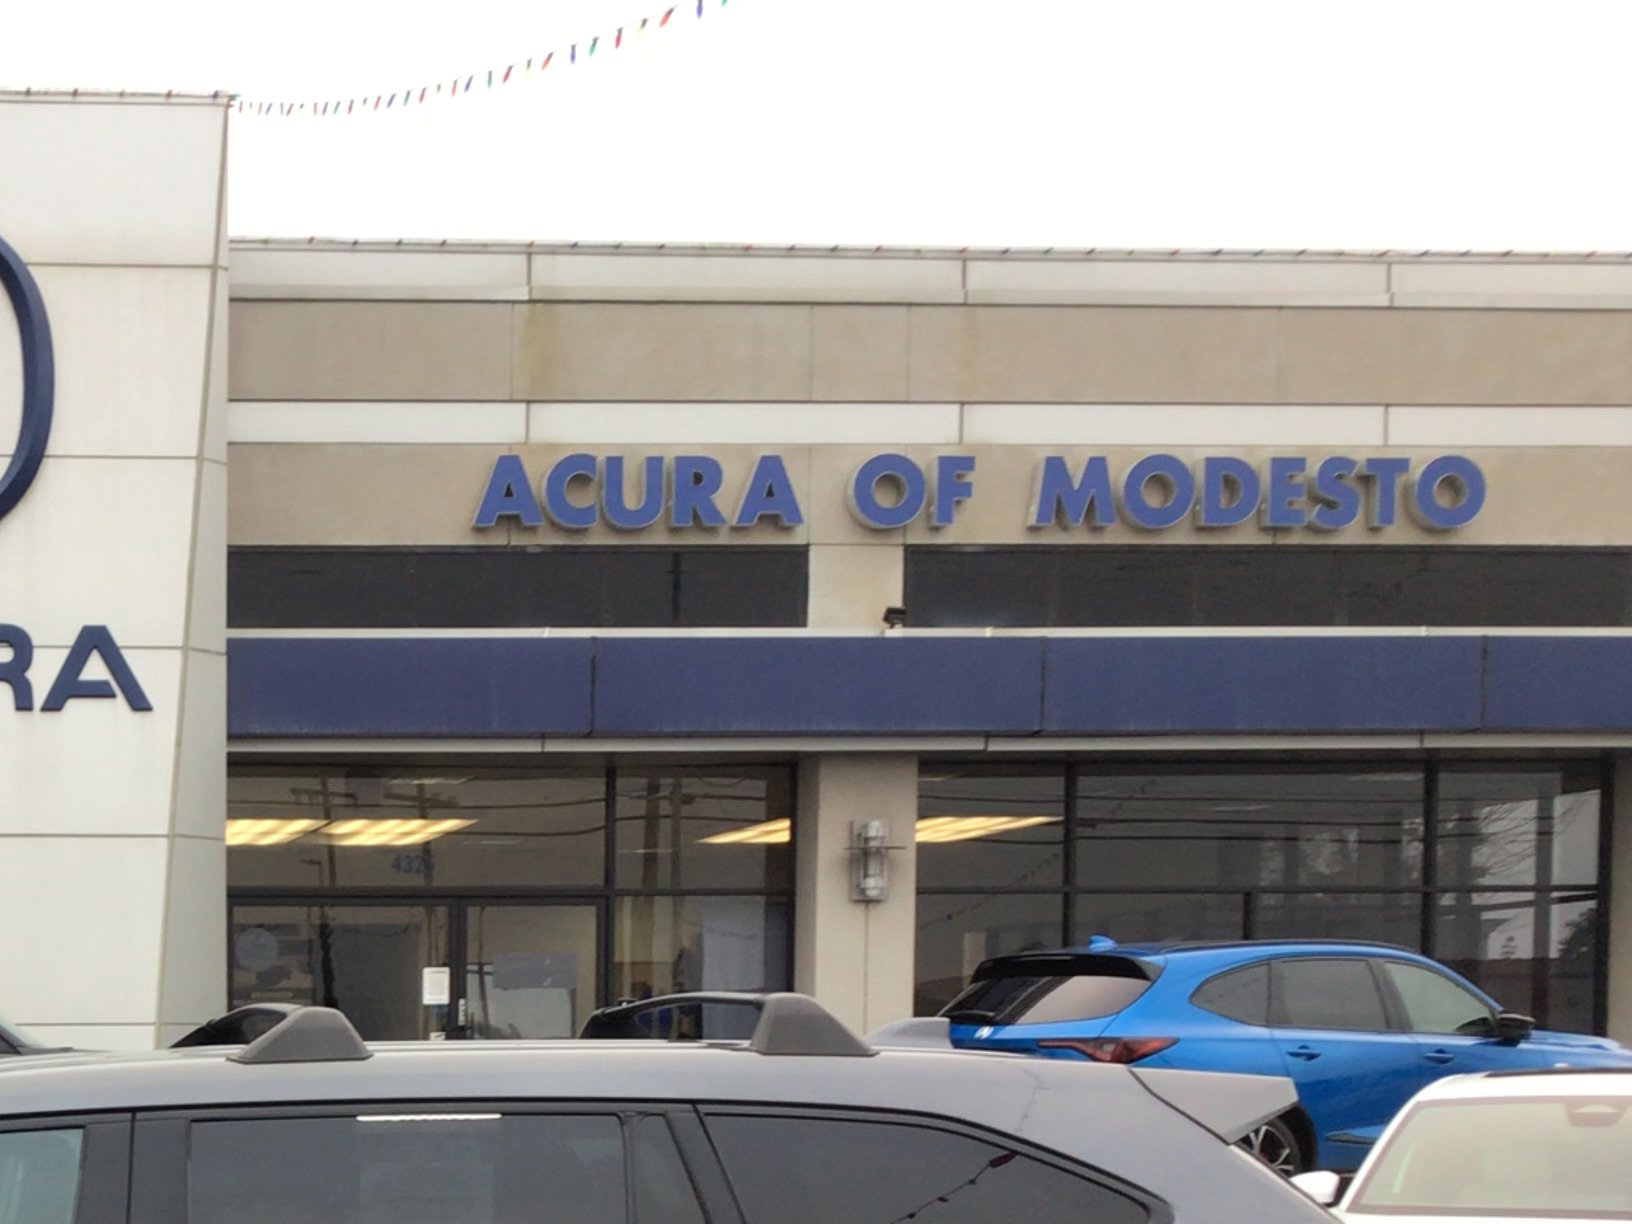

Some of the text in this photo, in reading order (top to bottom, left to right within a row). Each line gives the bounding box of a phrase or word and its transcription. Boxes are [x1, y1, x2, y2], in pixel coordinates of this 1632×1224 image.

[471, 452, 1487, 530] ACURA OF MODESTO
